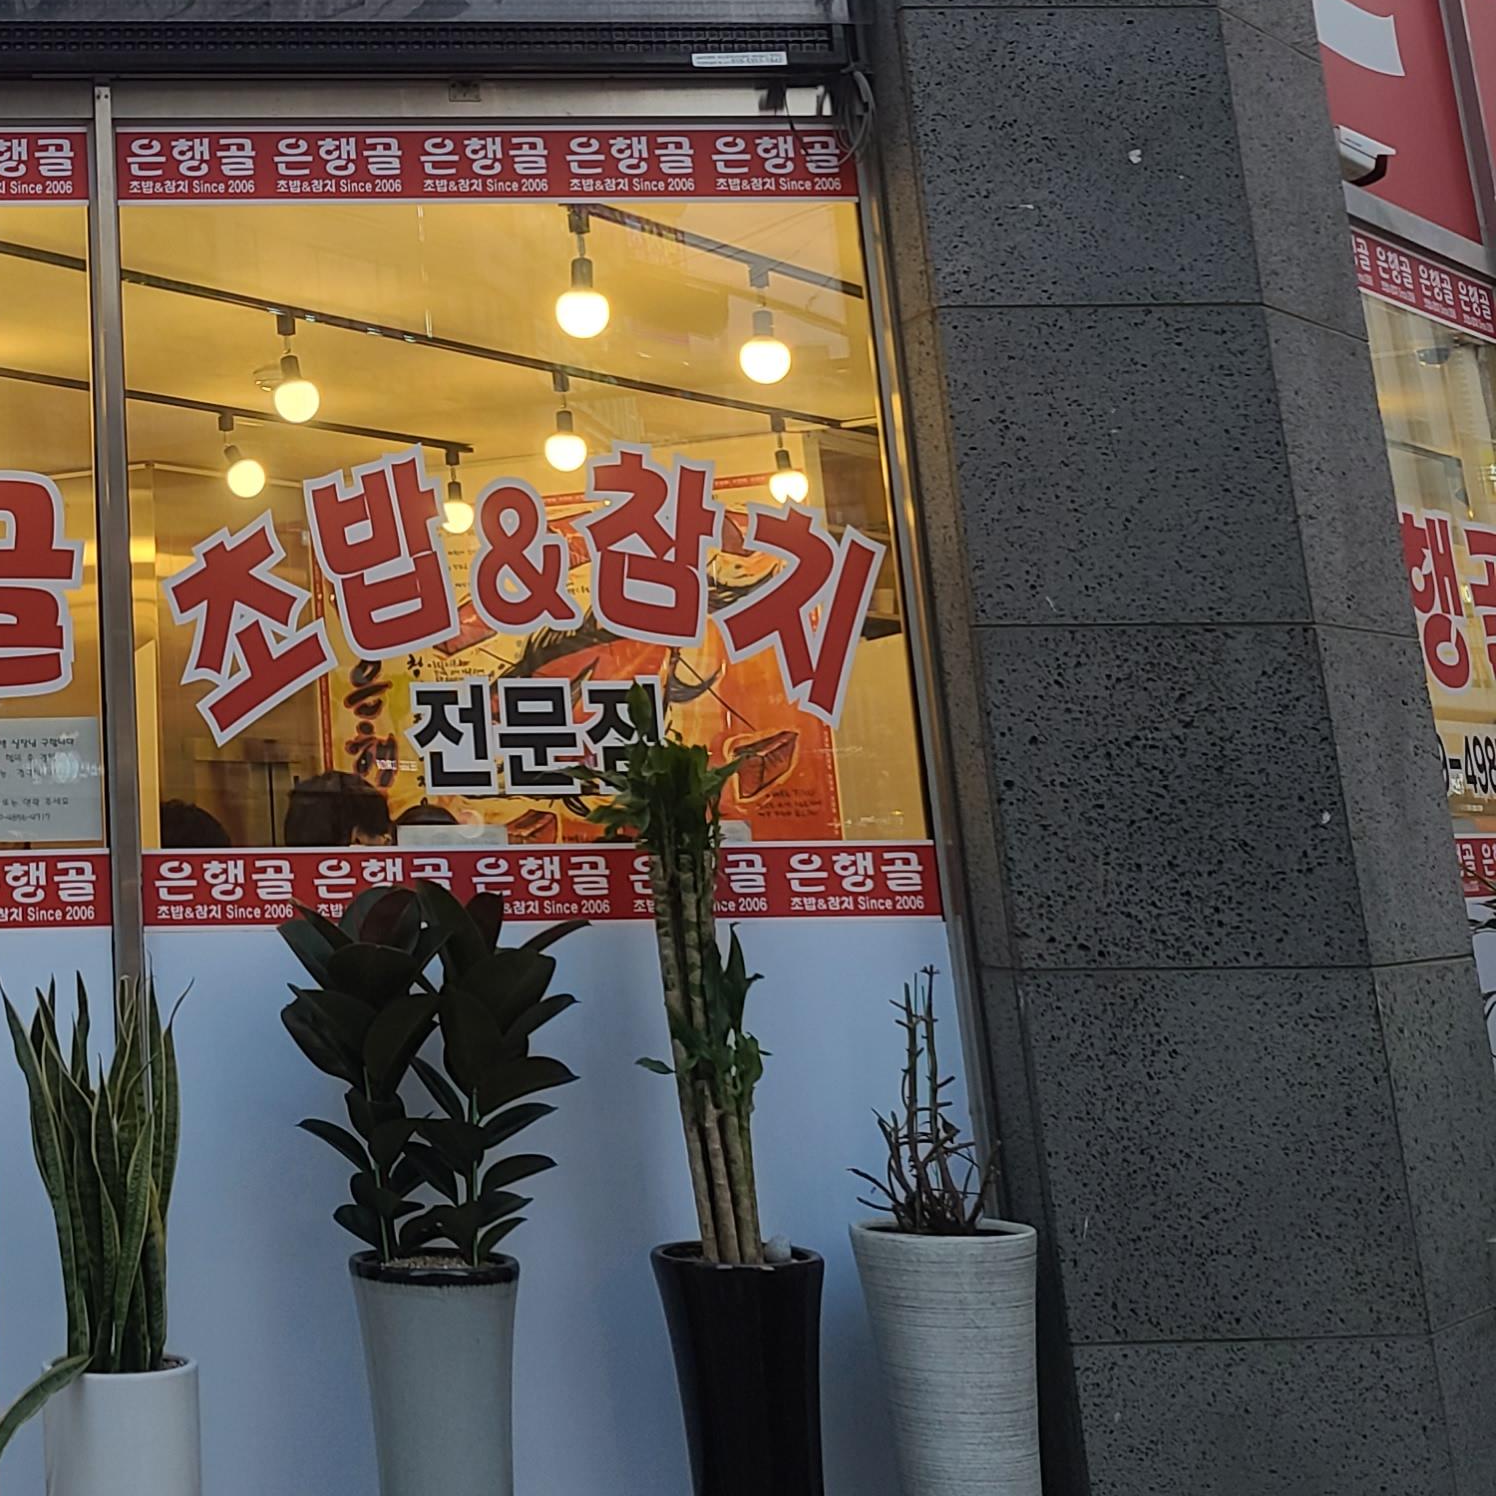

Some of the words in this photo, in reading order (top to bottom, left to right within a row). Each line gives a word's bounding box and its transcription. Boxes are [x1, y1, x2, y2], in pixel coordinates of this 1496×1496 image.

[127, 137, 255, 176] 은행골
[274, 137, 402, 176] 은행골
[420, 136, 548, 176] 은행골
[566, 136, 693, 174] 은행골
[712, 136, 842, 175] 은행골
[10, 181, 42, 194] Since
[46, 181, 72, 194] 2006
[192, 179, 225, 193] Since
[228, 179, 255, 193] 2006
[340, 179, 372, 193] Since
[374, 179, 402, 193] 2006
[487, 178, 519, 192] Since
[521, 178, 548, 192] 2006
[632, 177, 665, 192] Since
[667, 178, 695, 191] 2006
[779, 178, 812, 191] Since
[814, 177, 841, 190] 2006
[160, 442, 887, 748] 초밥&참치
[155, 859, 295, 902] 은행골
[472, 856, 610, 897] 은행골
[786, 852, 924, 894] 은행골
[543, 900, 578, 915] Since
[581, 899, 610, 914] 2006
[738, 896, 768, 912] 2006
[857, 895, 892, 910] Since
[895, 895, 924, 910] 2006
[27, 907, 63, 922] Since
[65, 905, 94, 921] 2006
[226, 904, 261, 919] Since
[264, 903, 293, 918] 2006
